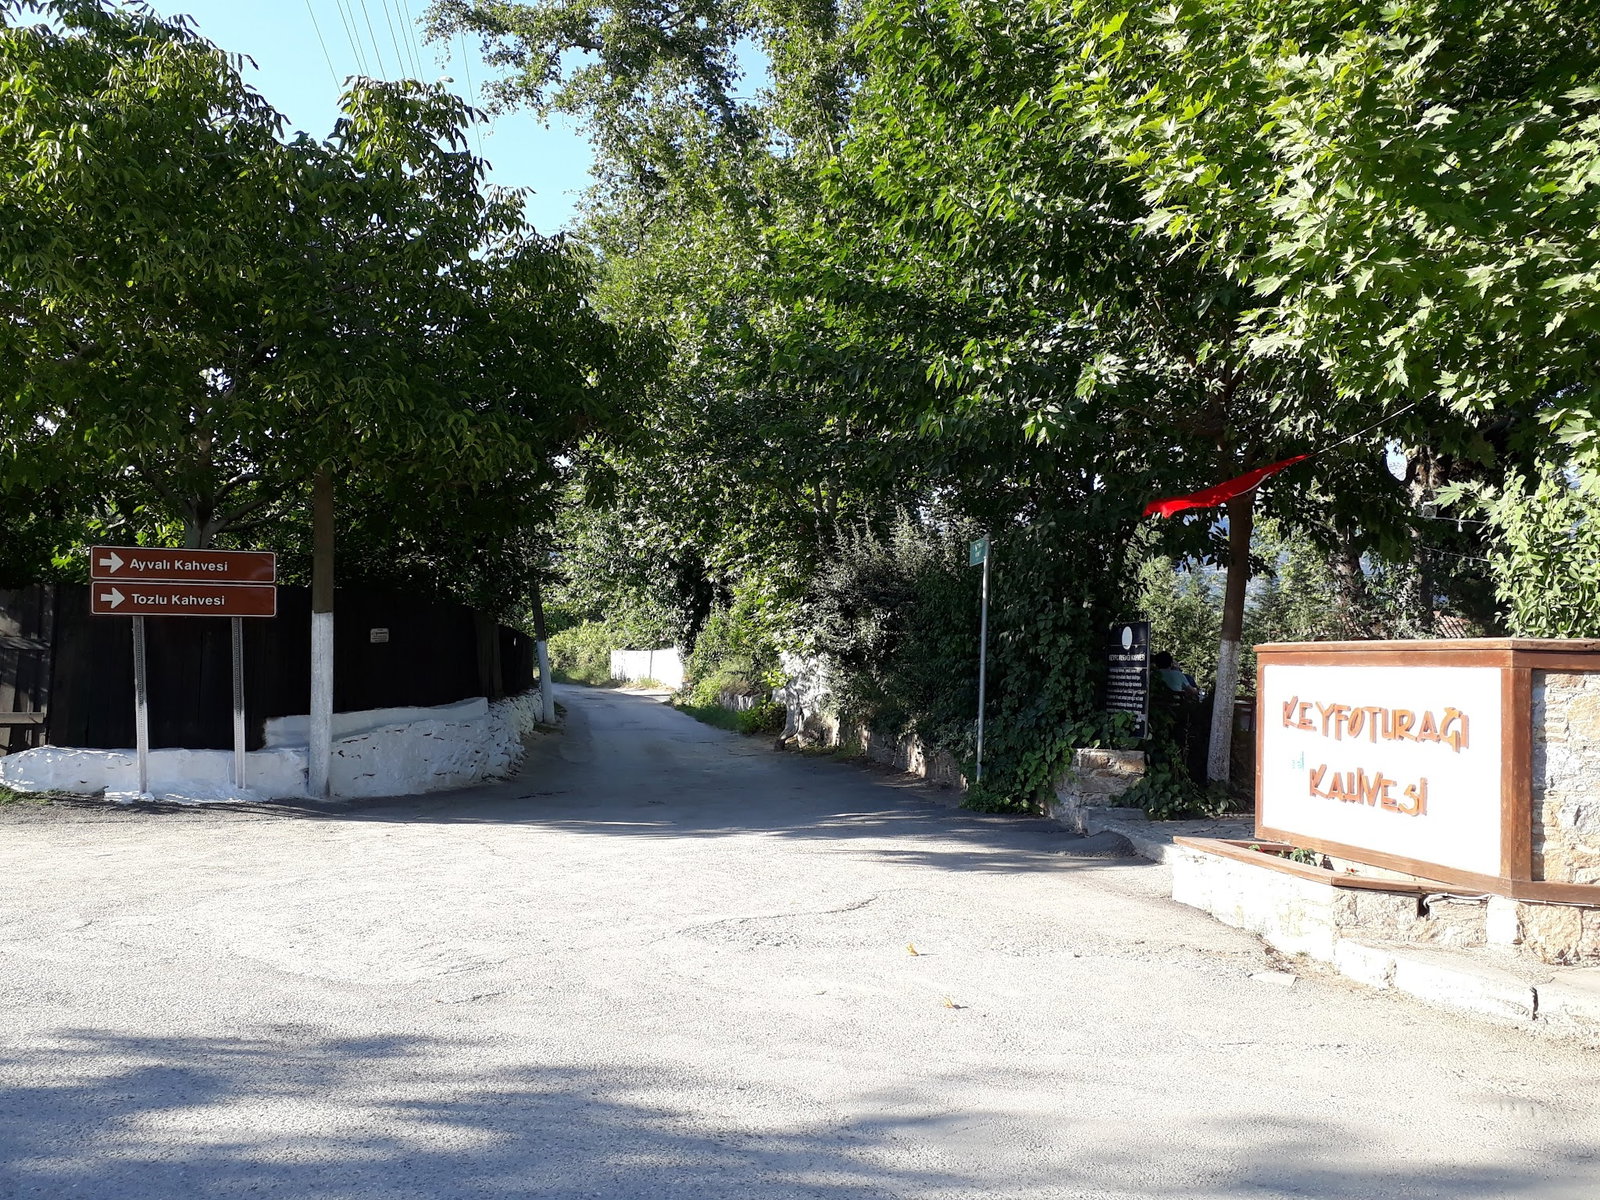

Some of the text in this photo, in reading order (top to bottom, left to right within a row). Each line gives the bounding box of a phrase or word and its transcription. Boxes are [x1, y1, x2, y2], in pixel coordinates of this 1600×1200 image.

[129, 558, 228, 572] Ayvalı Kahvesi
[131, 593, 225, 606] Tozlu Kahvesi
